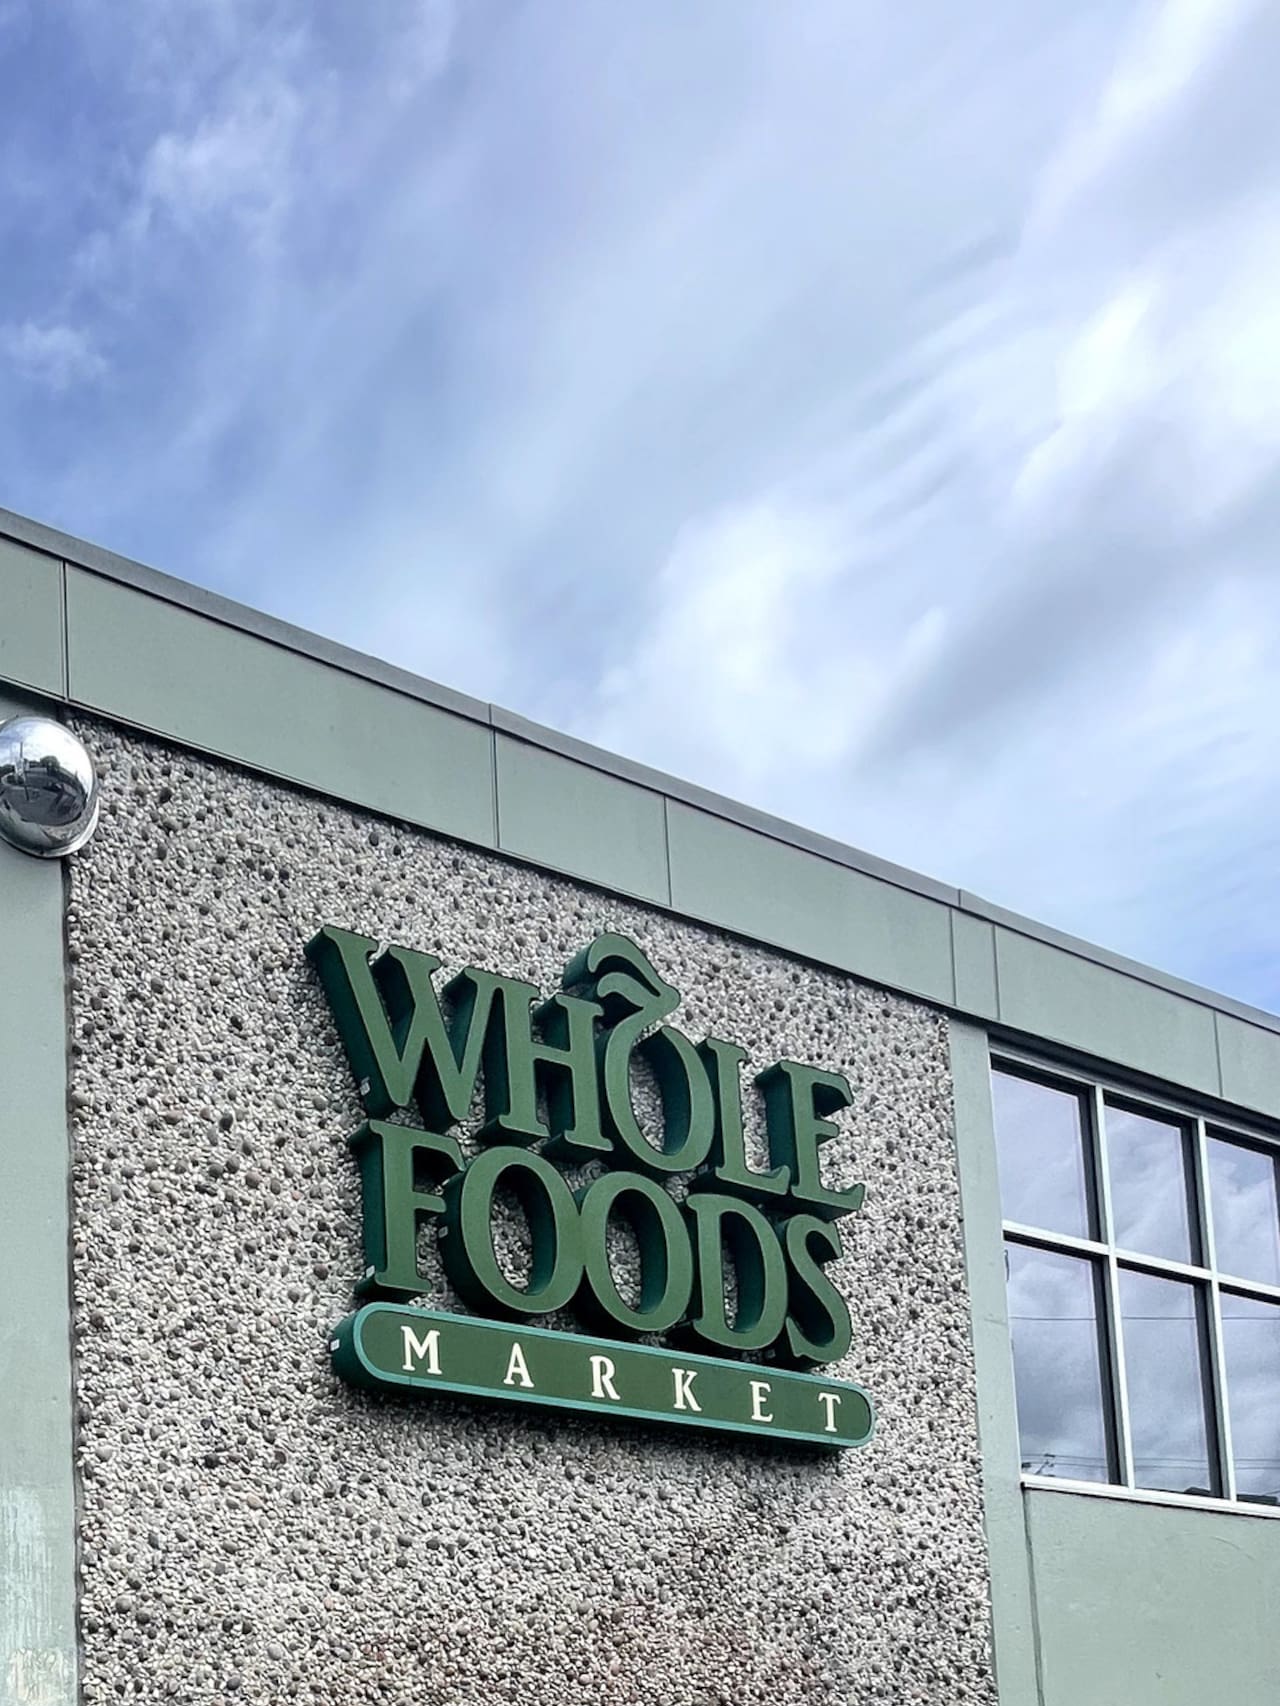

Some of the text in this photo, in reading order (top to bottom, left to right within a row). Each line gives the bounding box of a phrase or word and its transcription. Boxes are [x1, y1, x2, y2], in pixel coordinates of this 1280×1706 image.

[306, 925, 866, 1217] WHOLE
[350, 1119, 853, 1366] FOODS
[400, 1325, 842, 1433] MARKET
